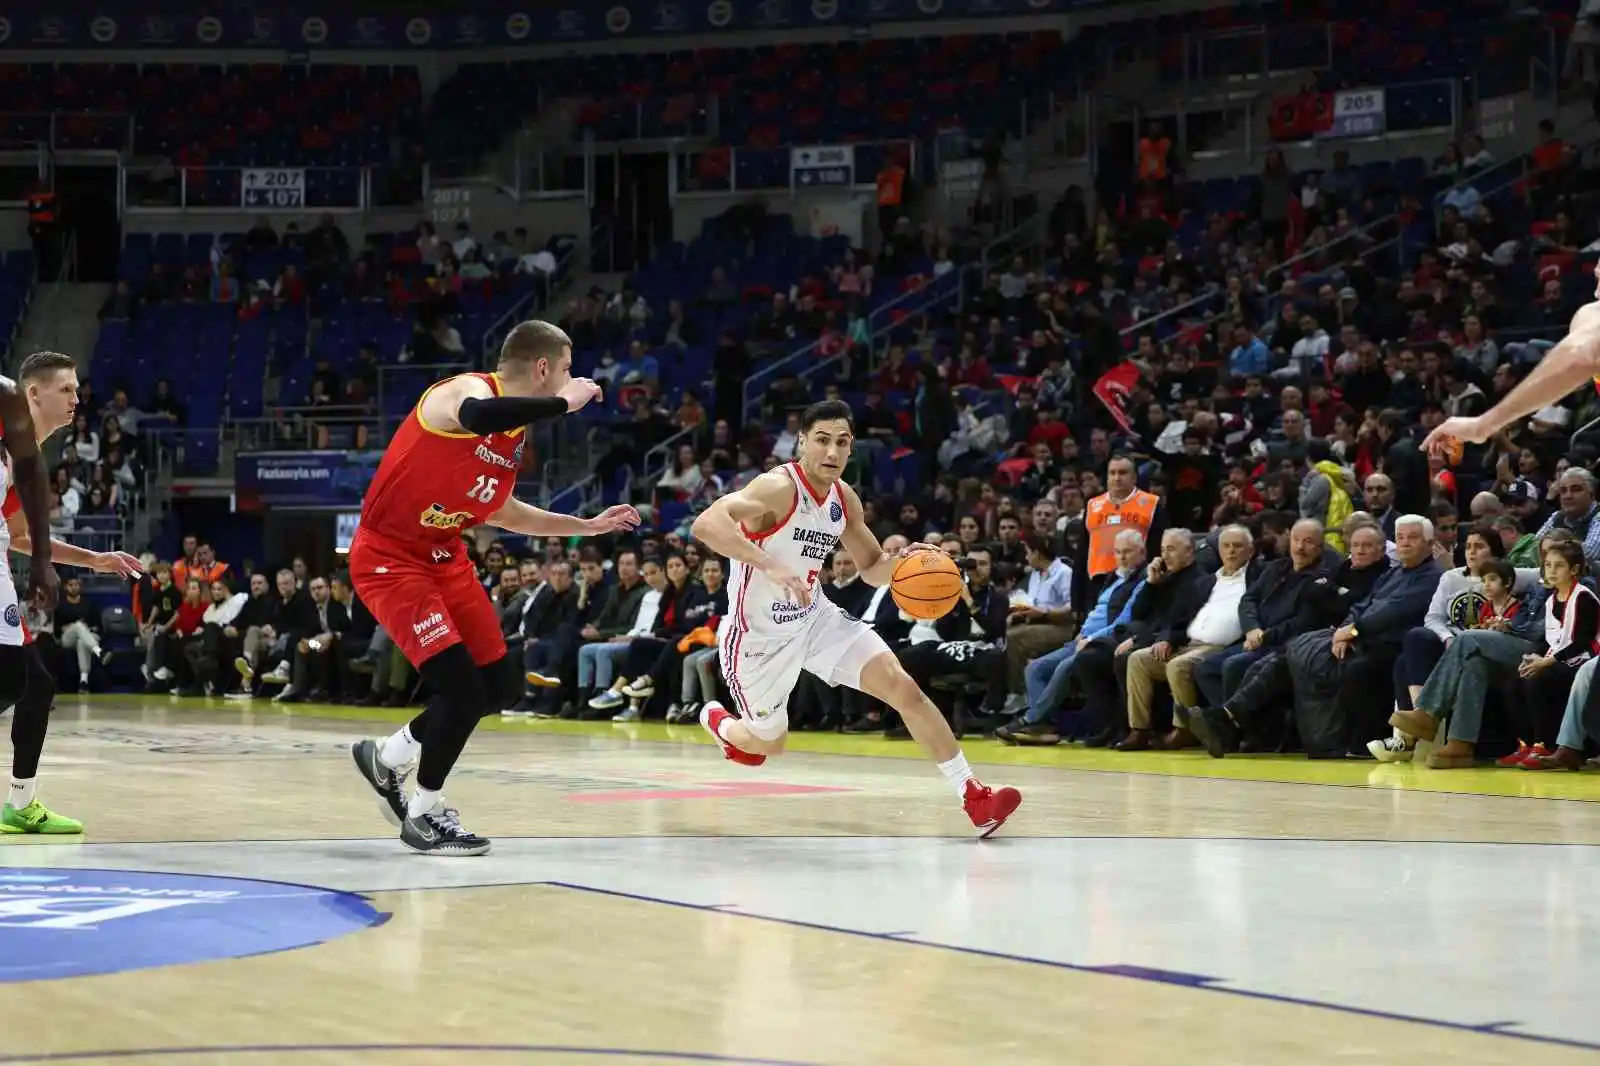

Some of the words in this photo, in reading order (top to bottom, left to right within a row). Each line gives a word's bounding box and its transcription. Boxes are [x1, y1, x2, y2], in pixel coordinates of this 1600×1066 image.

[264, 171, 300, 186] 207
[264, 189, 300, 207] 107
[466, 474, 498, 504] 16
[413, 612, 443, 636] bwin
